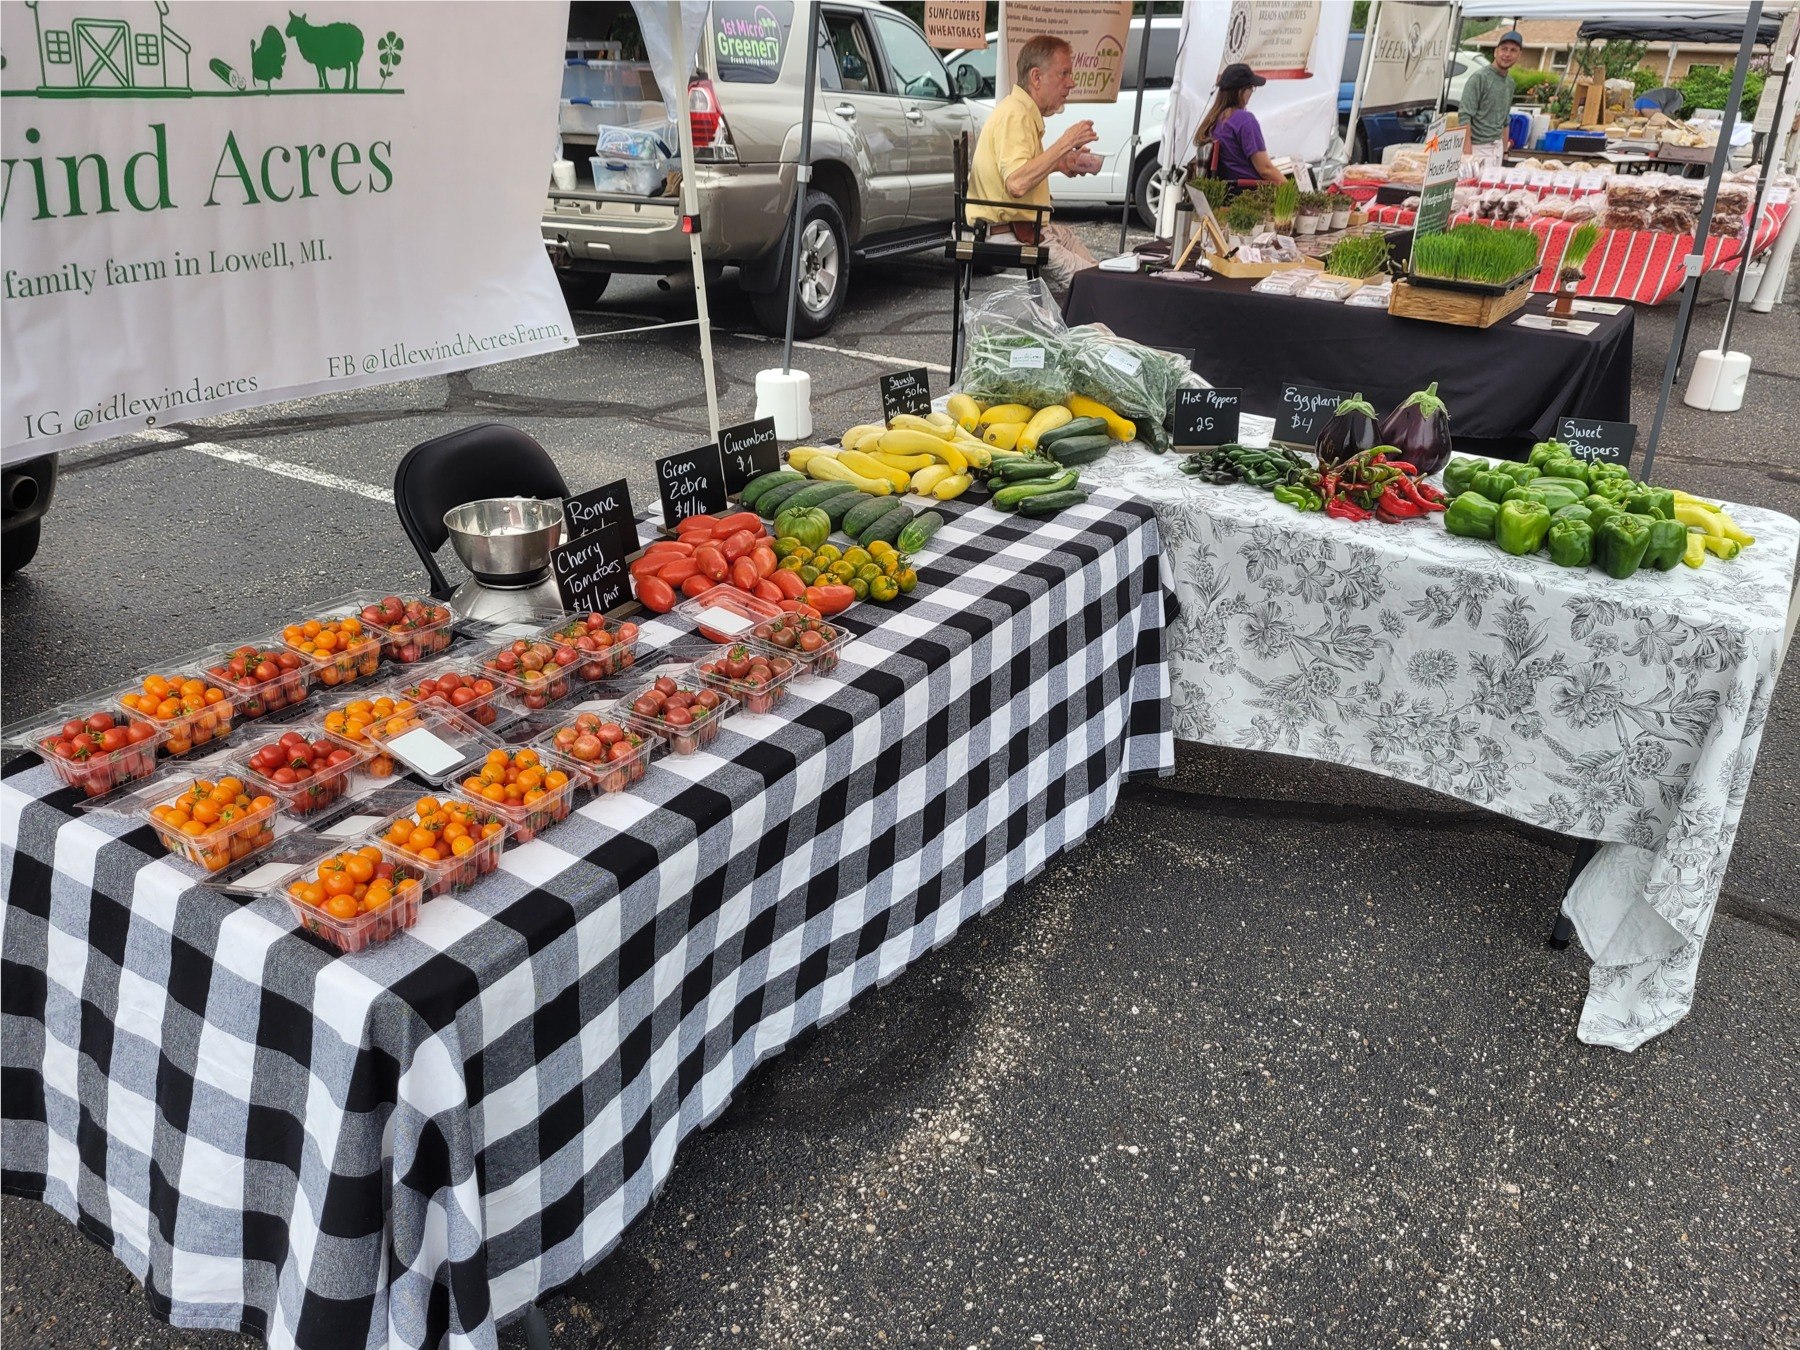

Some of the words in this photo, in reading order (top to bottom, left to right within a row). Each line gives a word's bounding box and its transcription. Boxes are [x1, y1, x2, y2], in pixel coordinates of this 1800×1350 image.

[929, 6, 980, 22] SUNFLOWERS
[721, 17, 736, 36] 1st
[736, 19, 764, 38] Micro
[928, 25, 982, 39] WHEATGRASS
[718, 32, 779, 64] Greenery
[1075, 52, 1099, 68] Micro
[1073, 71, 1112, 92] enery
[1437, 136, 1453, 152] rotect
[204, 129, 393, 207] Acres
[1428, 162, 1445, 178] House
[3, 263, 96, 299] family
[106, 258, 167, 286] farm
[174, 251, 201, 276] in
[209, 242, 294, 273] Lowell,
[300, 239, 333, 264] MI.
[327, 354, 356, 378] FB
[362, 323, 563, 373] @IdlewindAcresFarm
[889, 372, 915, 388] Squash
[24, 411, 62, 440] IG
[73, 375, 258, 431] @idlewindacres
[1181, 391, 1202, 405] Hot
[1206, 391, 1238, 409] Peppers
[1284, 387, 1341, 412] Eggplant
[1189, 417, 1214, 432] .25
[1291, 413, 1313, 433] $4
[1563, 420, 1603, 438] Sweet
[724, 428, 775, 454] Cucumbers
[1568, 440, 1620, 459] Peppers
[662, 460, 696, 478] Green
[737, 454, 761, 477] $1
[669, 477, 707, 499] Zebra
[567, 496, 619, 525] Roma
[557, 542, 604, 574] Cherry
[563, 559, 621, 594] Tomatoes
